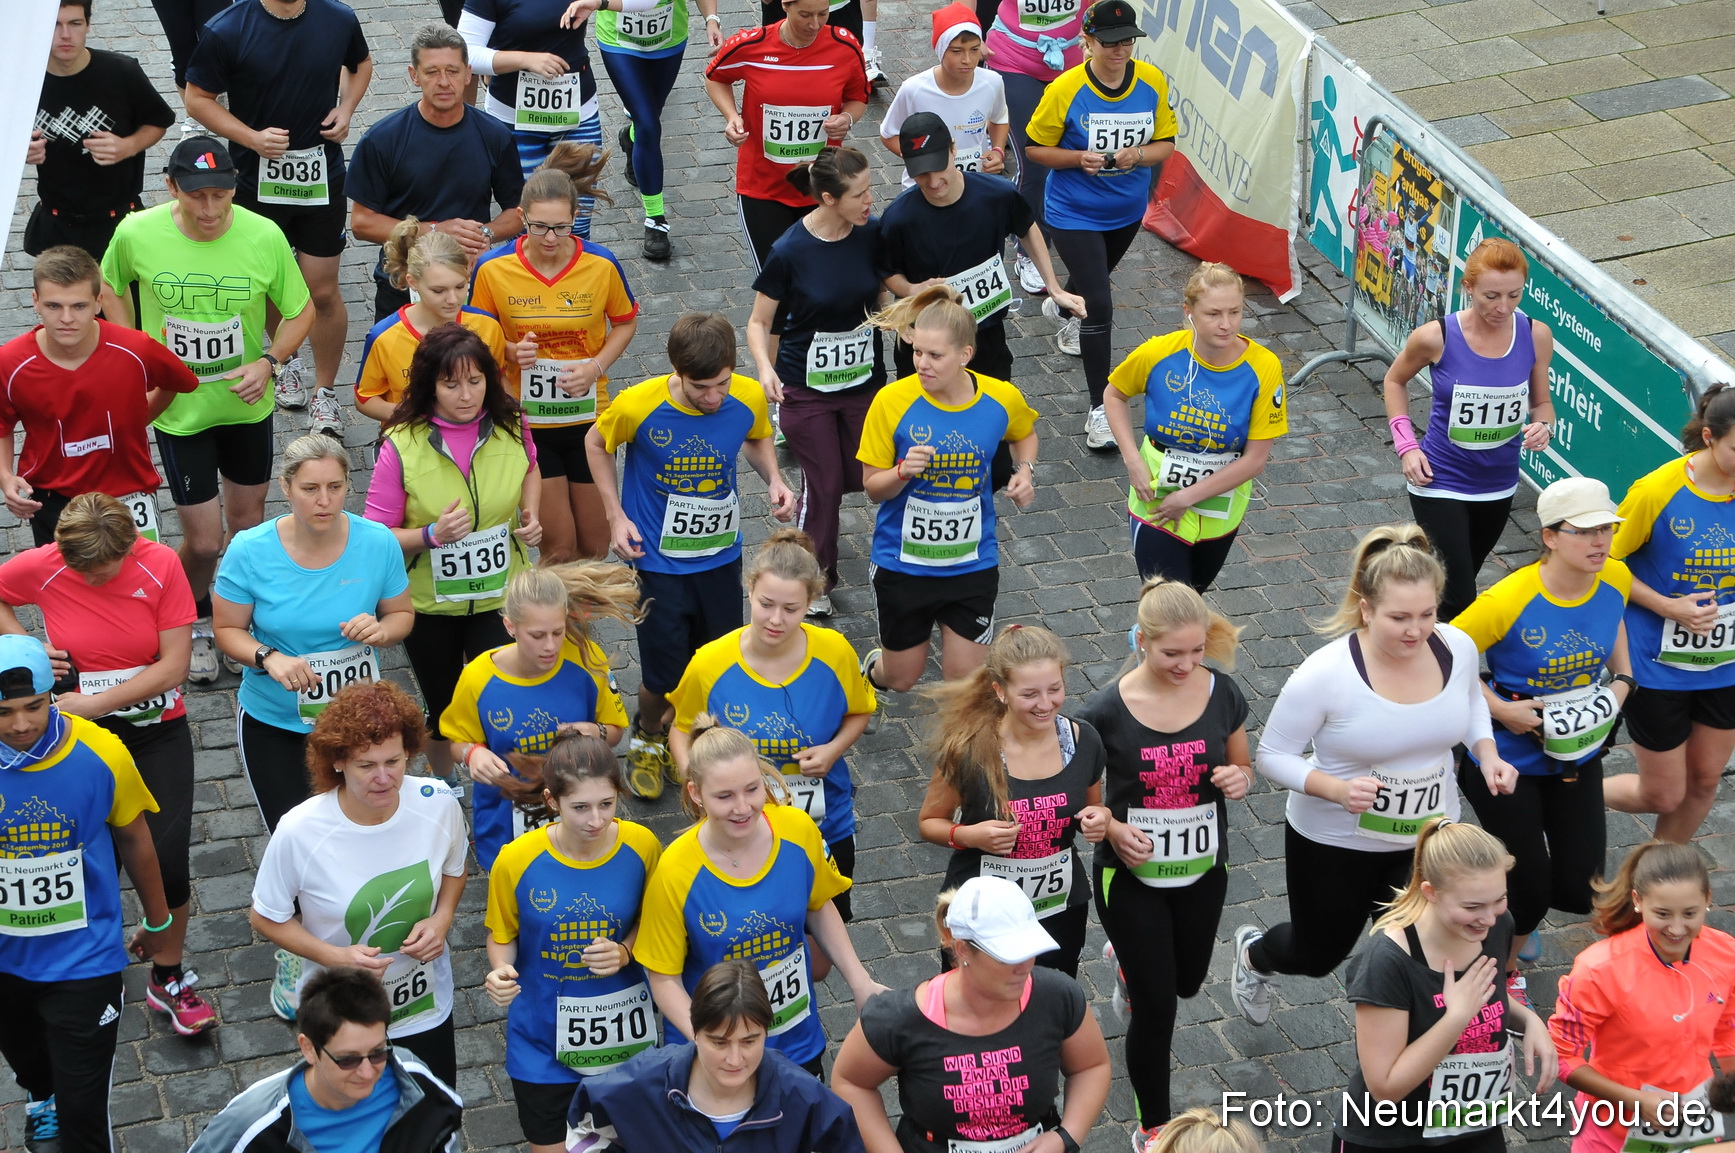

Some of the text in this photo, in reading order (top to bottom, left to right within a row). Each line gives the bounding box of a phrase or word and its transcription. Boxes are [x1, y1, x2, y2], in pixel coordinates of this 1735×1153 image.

[1025, 0, 1075, 14] 5048
[622, 14, 669, 36] 5167
[519, 76, 541, 85] PARTL
[523, 86, 573, 110] 5061
[528, 113, 568, 124] Reinhilde
[764, 109, 786, 118] PARTL
[769, 118, 824, 142] 5187
[1095, 127, 1146, 150] 5151
[779, 146, 810, 156] Kerstin
[266, 159, 322, 183] 5038
[273, 185, 313, 197] Christian
[1401, 176, 1431, 212] erdgas
[961, 265, 992, 285] Neumarkt
[151, 272, 251, 312] OPF
[961, 270, 1004, 305] 184
[508, 295, 541, 308] Deyerl
[974, 298, 1001, 319] astian
[1522, 277, 1602, 353] -Leit-Systeme
[167, 321, 230, 335] PARTL Neumarkt
[834, 332, 864, 342] Neumarkt
[174, 333, 234, 360] 5101
[815, 340, 869, 369] 5157
[188, 363, 224, 375] Helmut
[824, 371, 858, 383] Martina
[529, 374, 590, 399] 51
[1454, 391, 1519, 400] PARTL Neumarkt
[1548, 366, 1603, 432] erheit
[538, 404, 580, 415] Rebecca
[1458, 400, 1522, 425] 5113
[1474, 430, 1502, 441] Heidi
[77, 441, 97, 452] DEHN
[1165, 453, 1227, 466] PARTL Neumarkt
[668, 499, 732, 512] PARTL Neumarkt
[906, 503, 970, 516] PARTL Neumarkt
[671, 509, 734, 536] 5531
[911, 515, 975, 542] 5537
[461, 534, 499, 548] Neumarkt
[911, 544, 958, 559] Tatjana
[441, 542, 506, 578] 5136
[469, 580, 485, 591] Evi
[309, 651, 363, 668] RTL Neumarkt
[1691, 654, 1716, 664] Ines
[82, 679, 113, 688] PARTL
[1548, 694, 1613, 736] 5210
[1141, 740, 1206, 760] WIR SIND
[1155, 754, 1194, 770] ZWAR
[1370, 770, 1438, 786] PARTL Neumarkt
[1002, 793, 1068, 813] IR SIND
[1372, 782, 1441, 815] 5170
[1016, 808, 1056, 823] ZWAR
[1130, 815, 1204, 825] PARTL Neumarkt
[1046, 817, 1071, 833] DIE
[1392, 821, 1417, 833] Lisa
[1017, 840, 1051, 852] ABER
[14, 862, 64, 875] Neumarkt
[983, 860, 1058, 873] PARTL Neumarkt
[1157, 863, 1189, 876] Frizzi
[9, 911, 56, 926] Patrick
[393, 970, 428, 1007] 66
[770, 968, 801, 1007] 45
[559, 996, 637, 1014] PARTL Neumarkt
[1481, 1000, 1504, 1022] DIE
[567, 1006, 648, 1048] 5510
[563, 1050, 632, 1067] Ramona
[943, 1046, 1022, 1072] WIR SIND
[1436, 1061, 1469, 1070] PARTL
[961, 1063, 1008, 1084] ZWAR
[943, 1074, 1029, 1100] NICHT DIE
[1440, 1063, 1512, 1103] 5072
